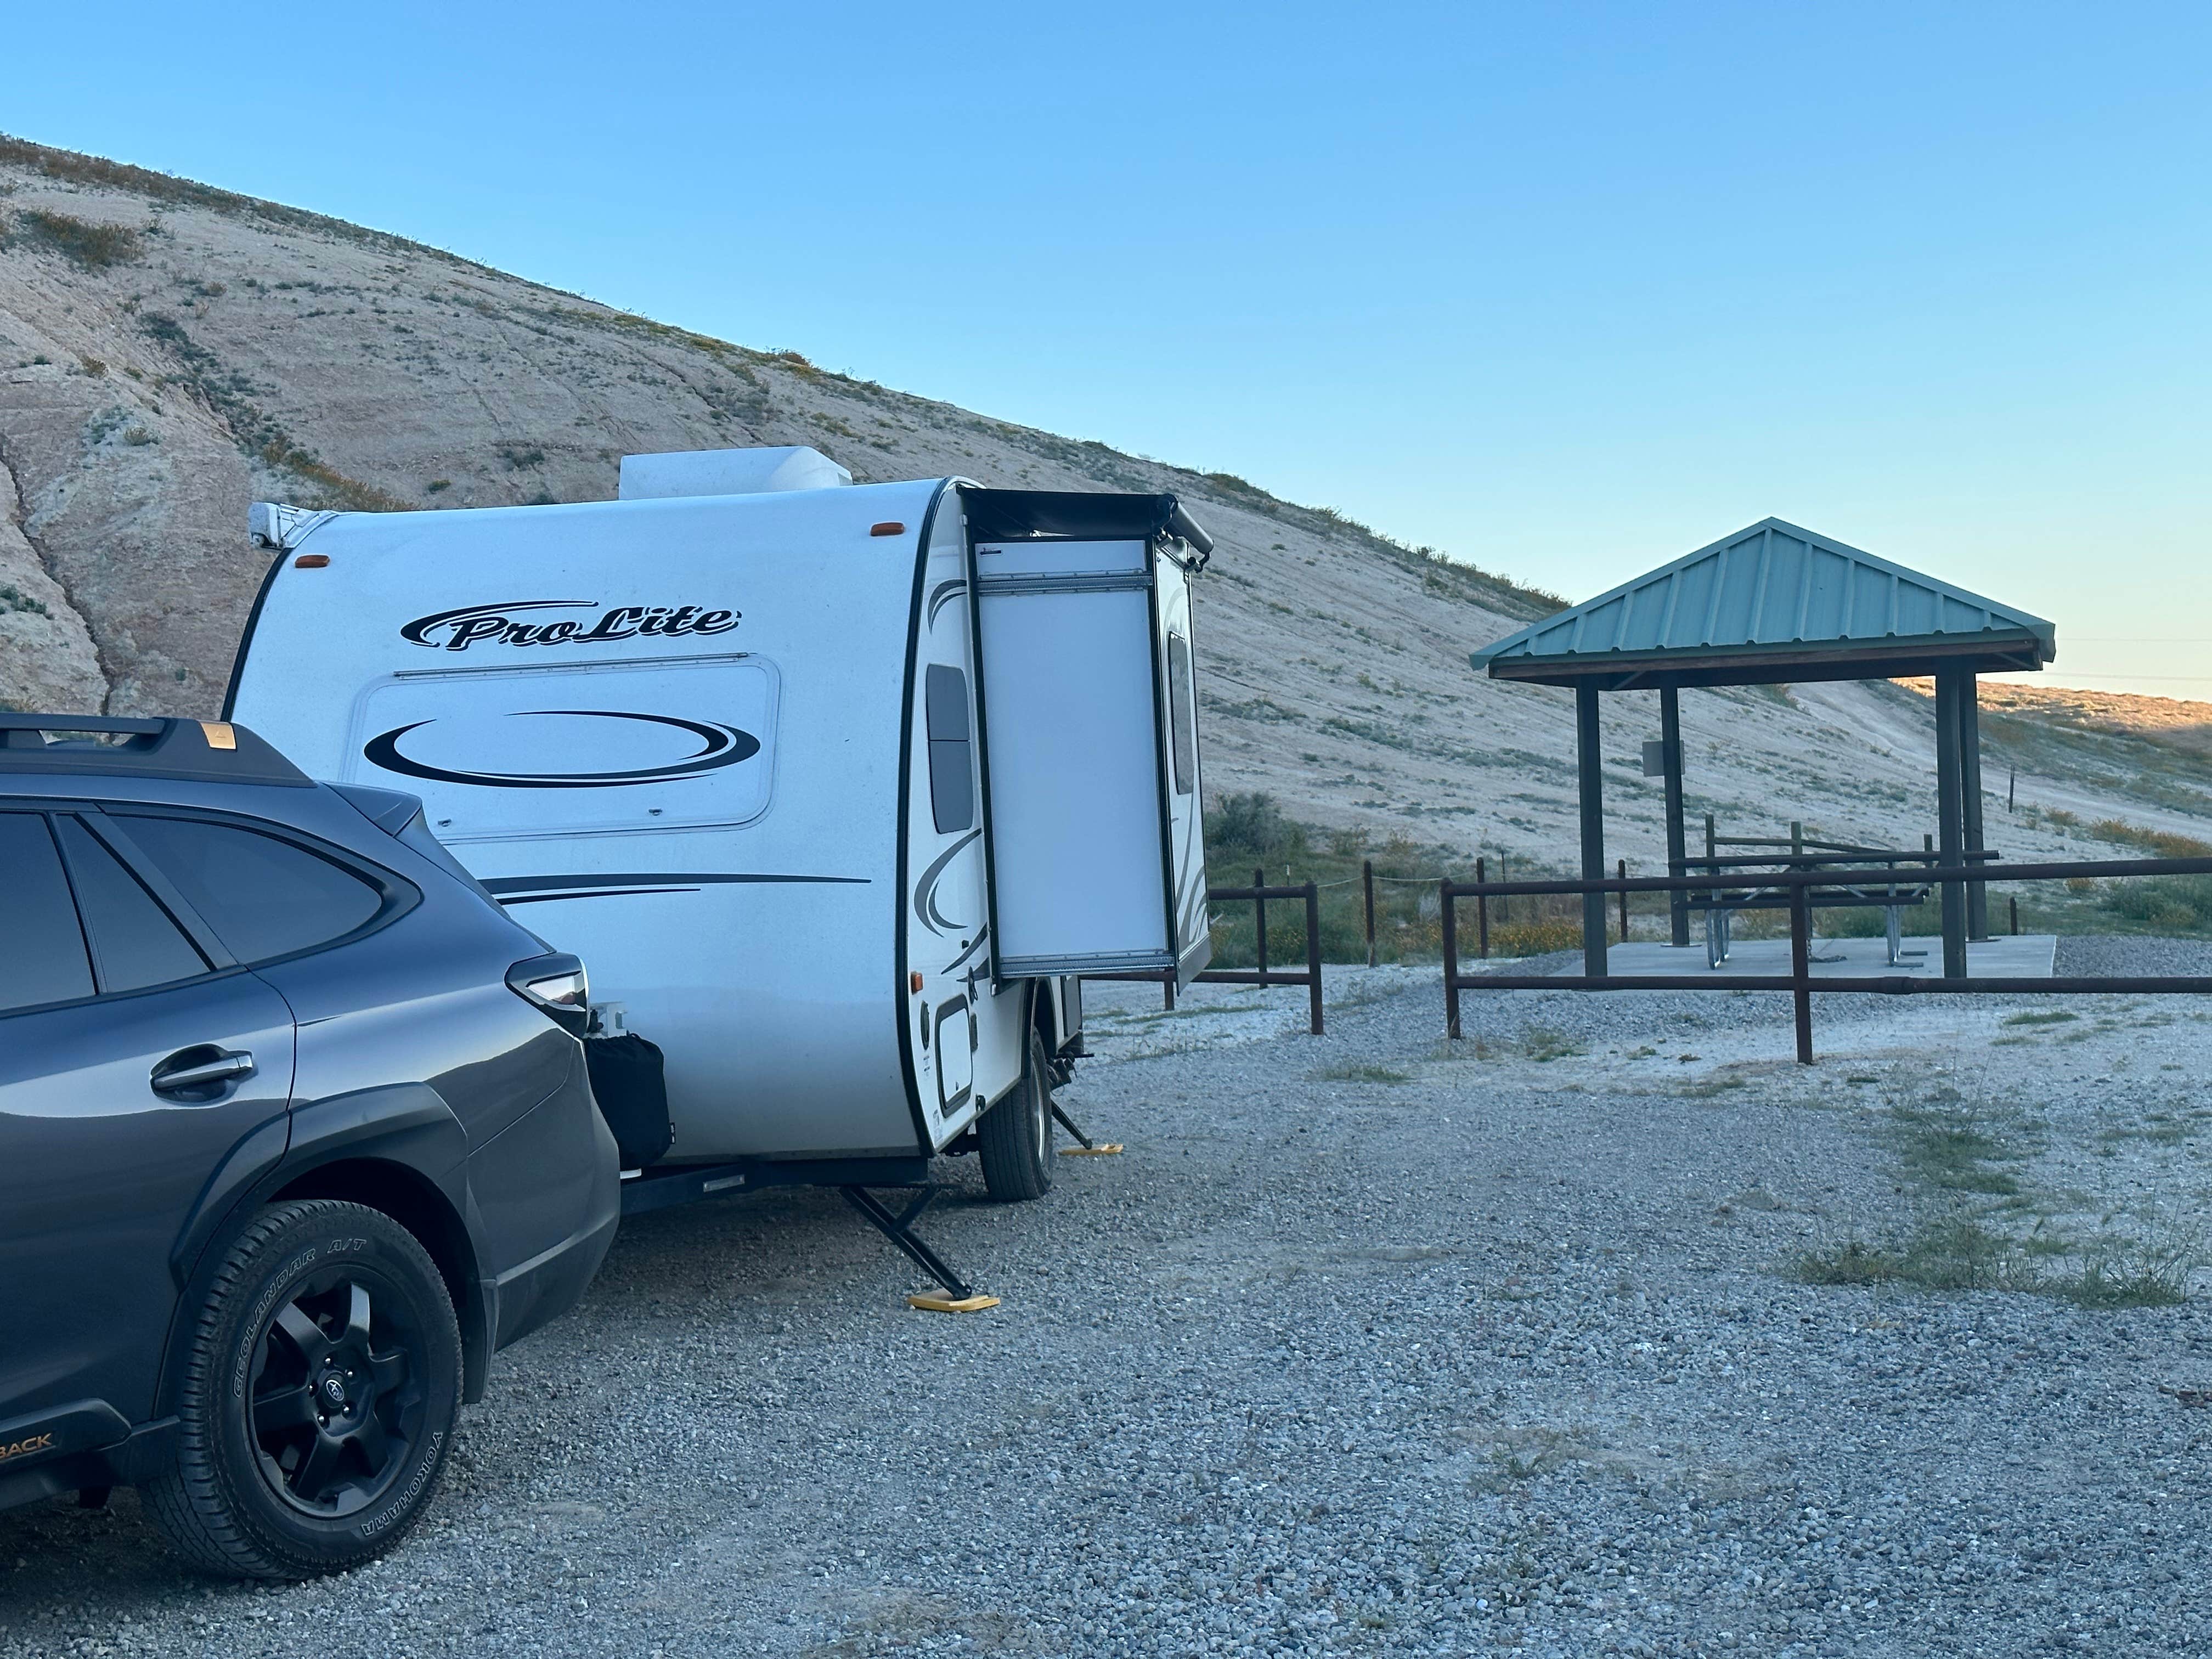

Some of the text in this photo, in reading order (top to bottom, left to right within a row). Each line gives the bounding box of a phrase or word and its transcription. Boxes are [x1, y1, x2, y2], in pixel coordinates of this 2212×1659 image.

[234, 1238, 367, 1398] GEOLANDAR A/T
[361, 1432, 443, 1536] YOKOHAMA
